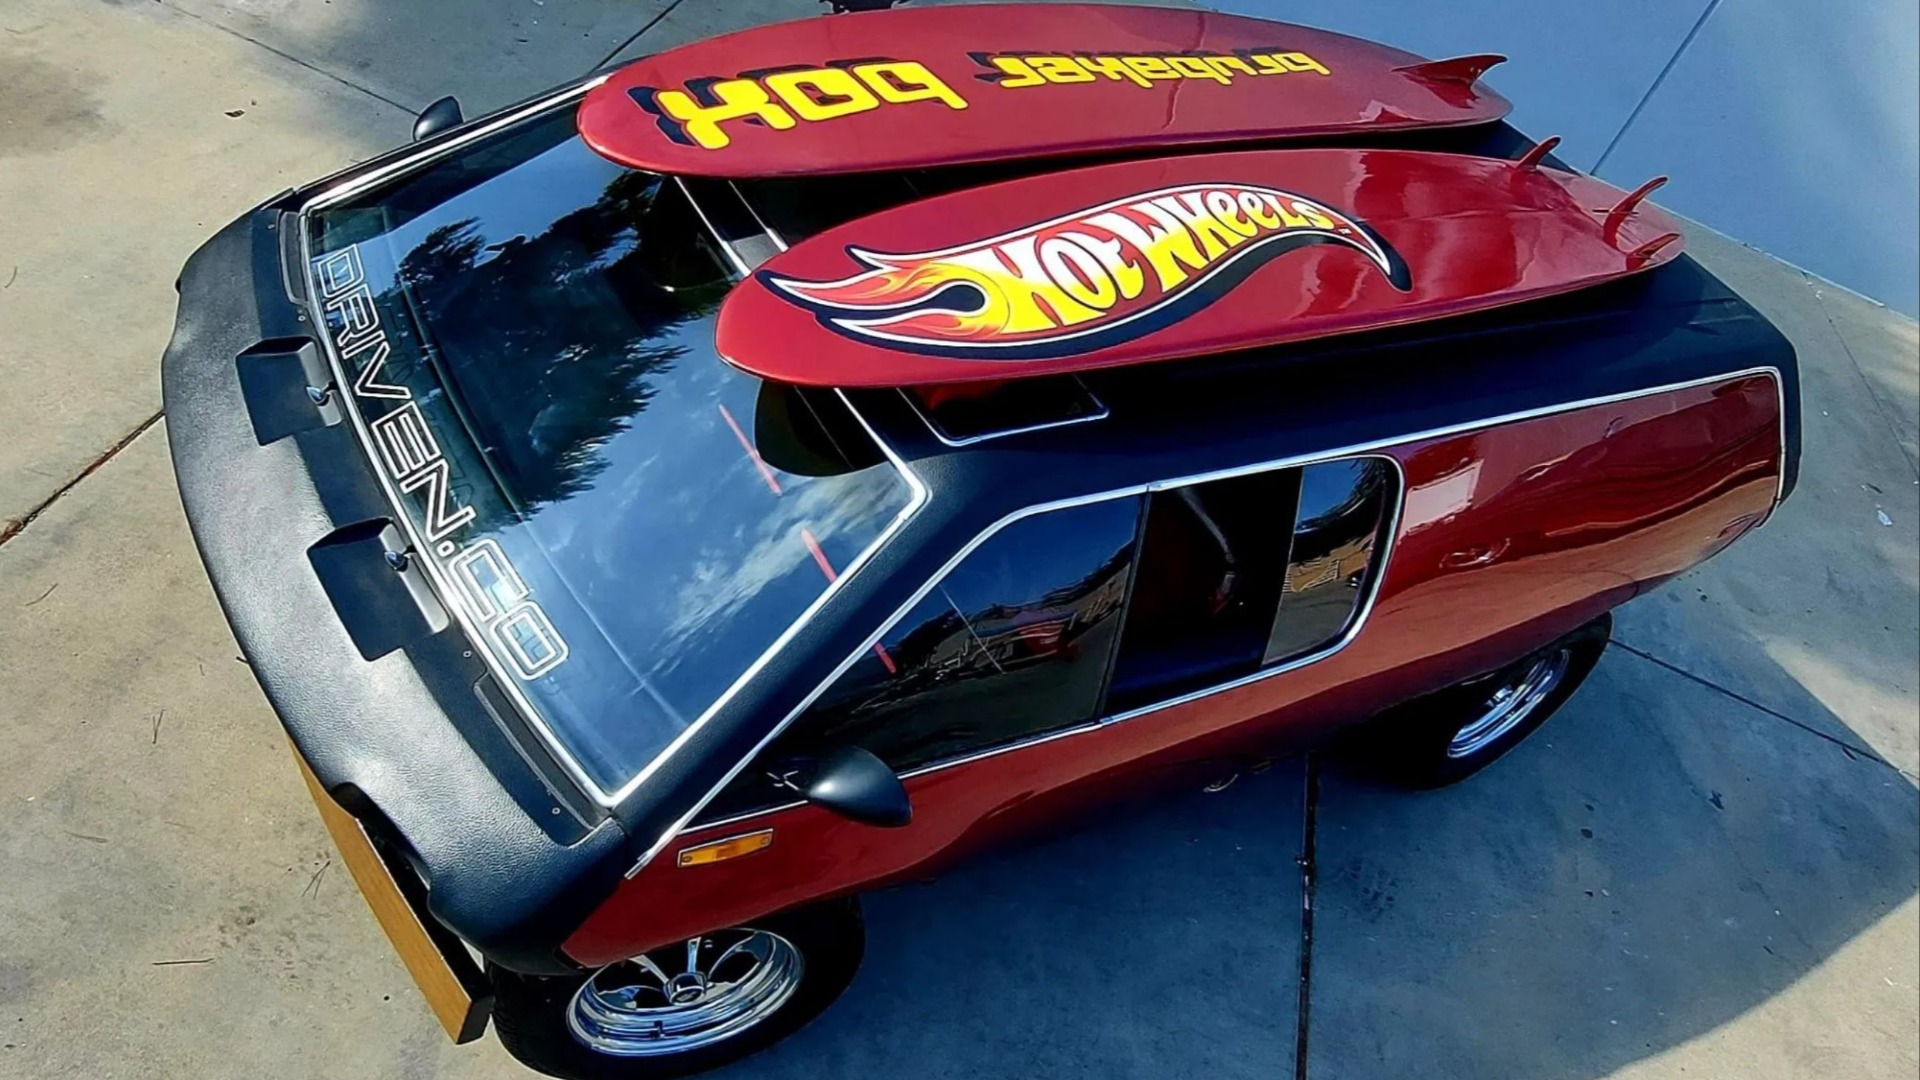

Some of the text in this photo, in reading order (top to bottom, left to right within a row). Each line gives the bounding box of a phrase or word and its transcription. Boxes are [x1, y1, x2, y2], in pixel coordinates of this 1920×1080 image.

[656, 51, 1332, 150] brubaker box
[315, 243, 570, 681] DRIVEN.CO
